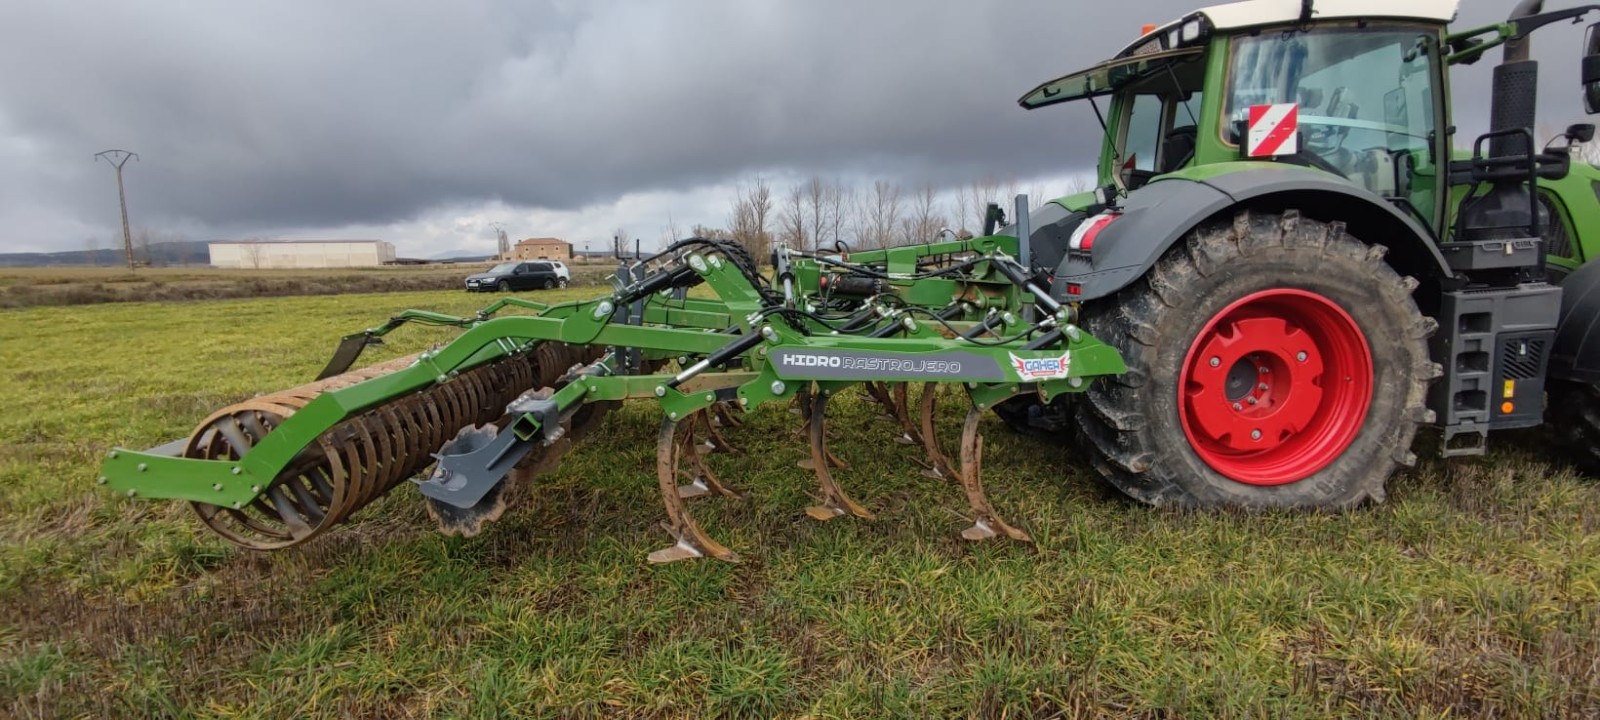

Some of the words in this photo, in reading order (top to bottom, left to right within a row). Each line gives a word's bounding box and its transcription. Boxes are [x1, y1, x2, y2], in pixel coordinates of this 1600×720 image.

[783, 354, 841, 368] HIDRO
[842, 356, 961, 374] RASTROJERO
[1024, 359, 1060, 371] GAHER
